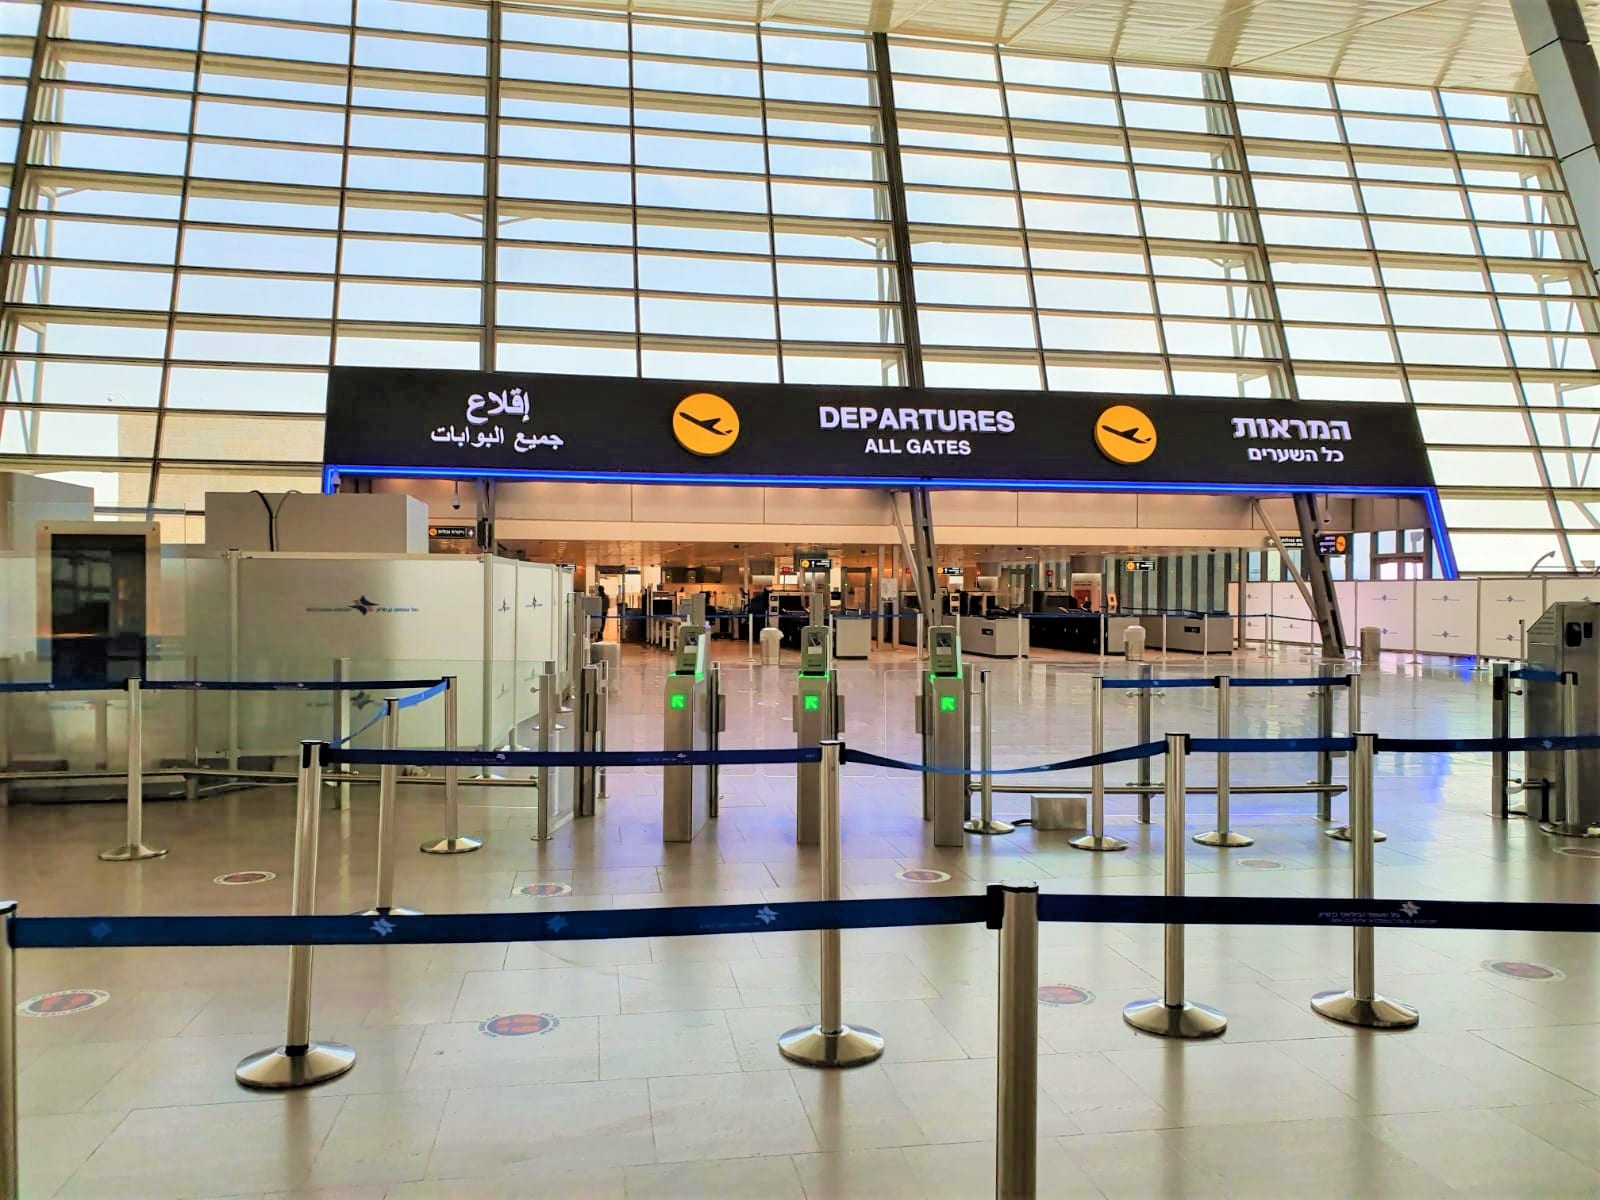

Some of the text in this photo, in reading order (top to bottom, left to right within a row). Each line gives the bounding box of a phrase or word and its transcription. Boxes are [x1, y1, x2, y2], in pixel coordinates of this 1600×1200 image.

[466, 388, 530, 423] إقلاع
[819, 406, 1015, 433] DEPARTURES
[1231, 417, 1352, 441] המראות
[430, 425, 565, 453] جميع البوابات
[864, 438, 972, 455] ALL GATES
[1247, 446, 1345, 463] כל השערים
